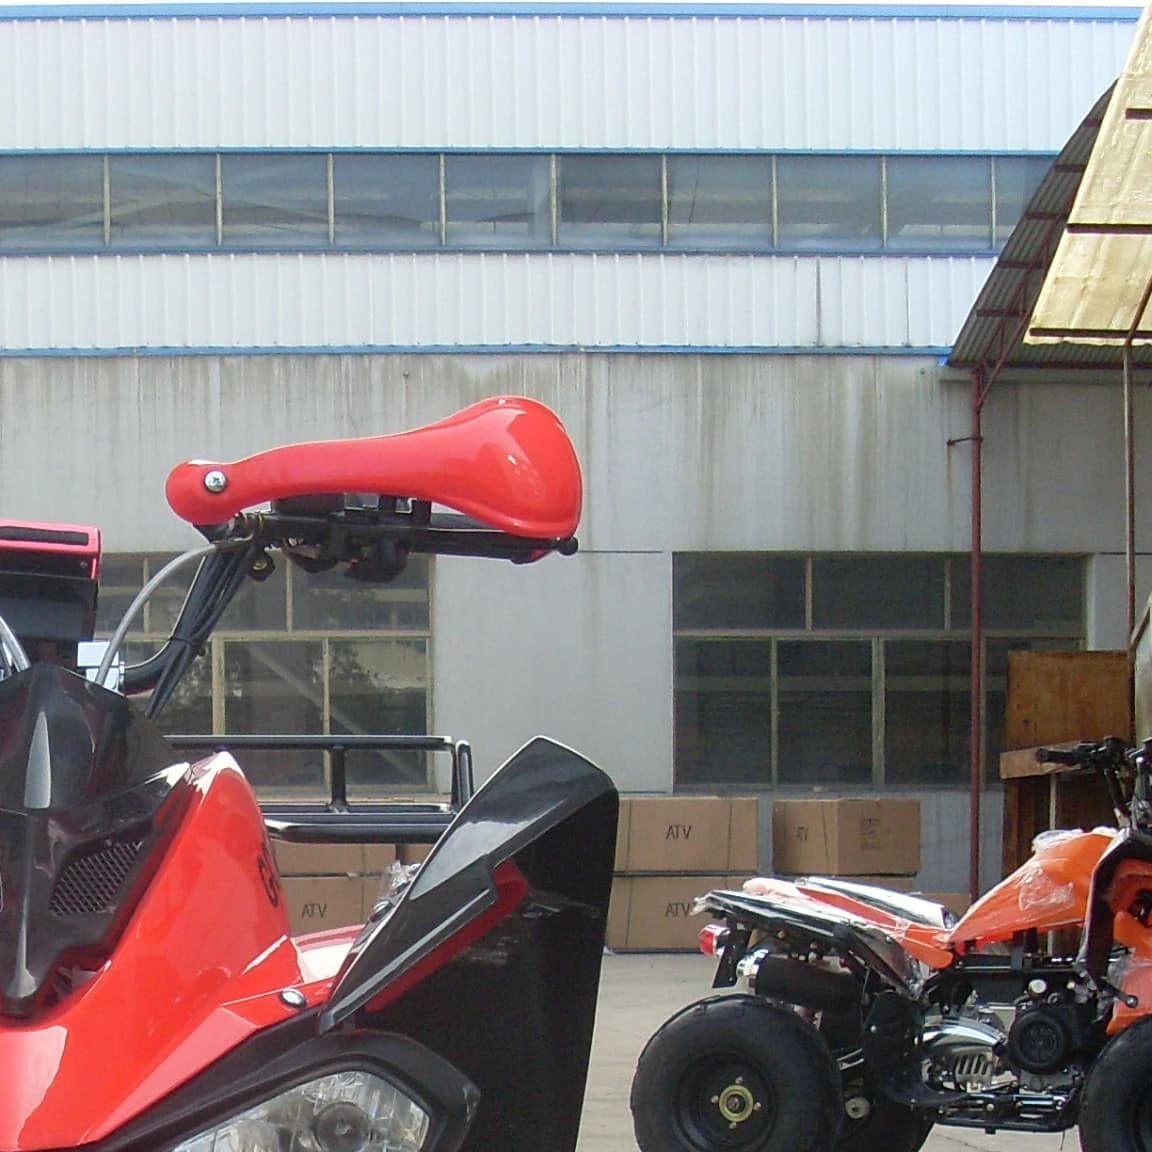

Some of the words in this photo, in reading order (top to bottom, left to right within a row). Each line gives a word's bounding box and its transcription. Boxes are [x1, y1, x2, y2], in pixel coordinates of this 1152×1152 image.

[665, 824, 692, 840] ATV
[301, 903, 328, 919] ATV
[664, 902, 692, 918] ATV
